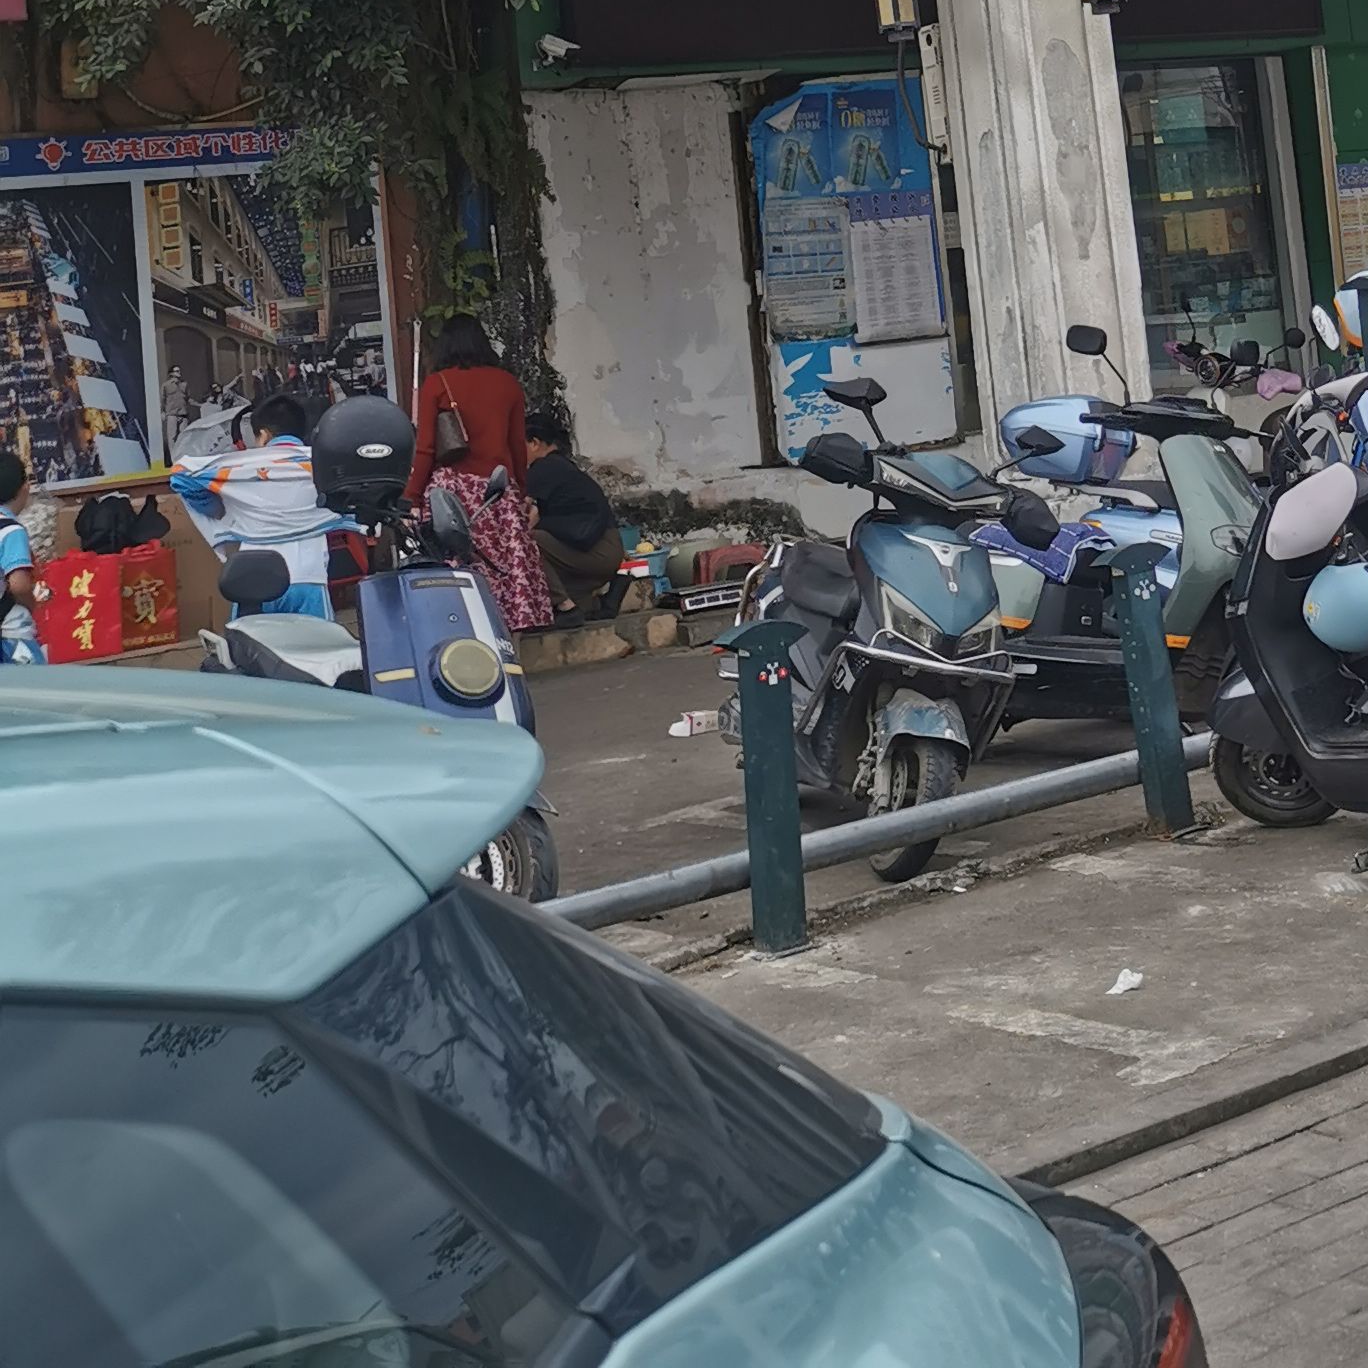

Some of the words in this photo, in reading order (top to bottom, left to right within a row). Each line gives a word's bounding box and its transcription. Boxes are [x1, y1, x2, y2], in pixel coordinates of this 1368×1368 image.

[82, 129, 300, 164] 公共区域个性化
